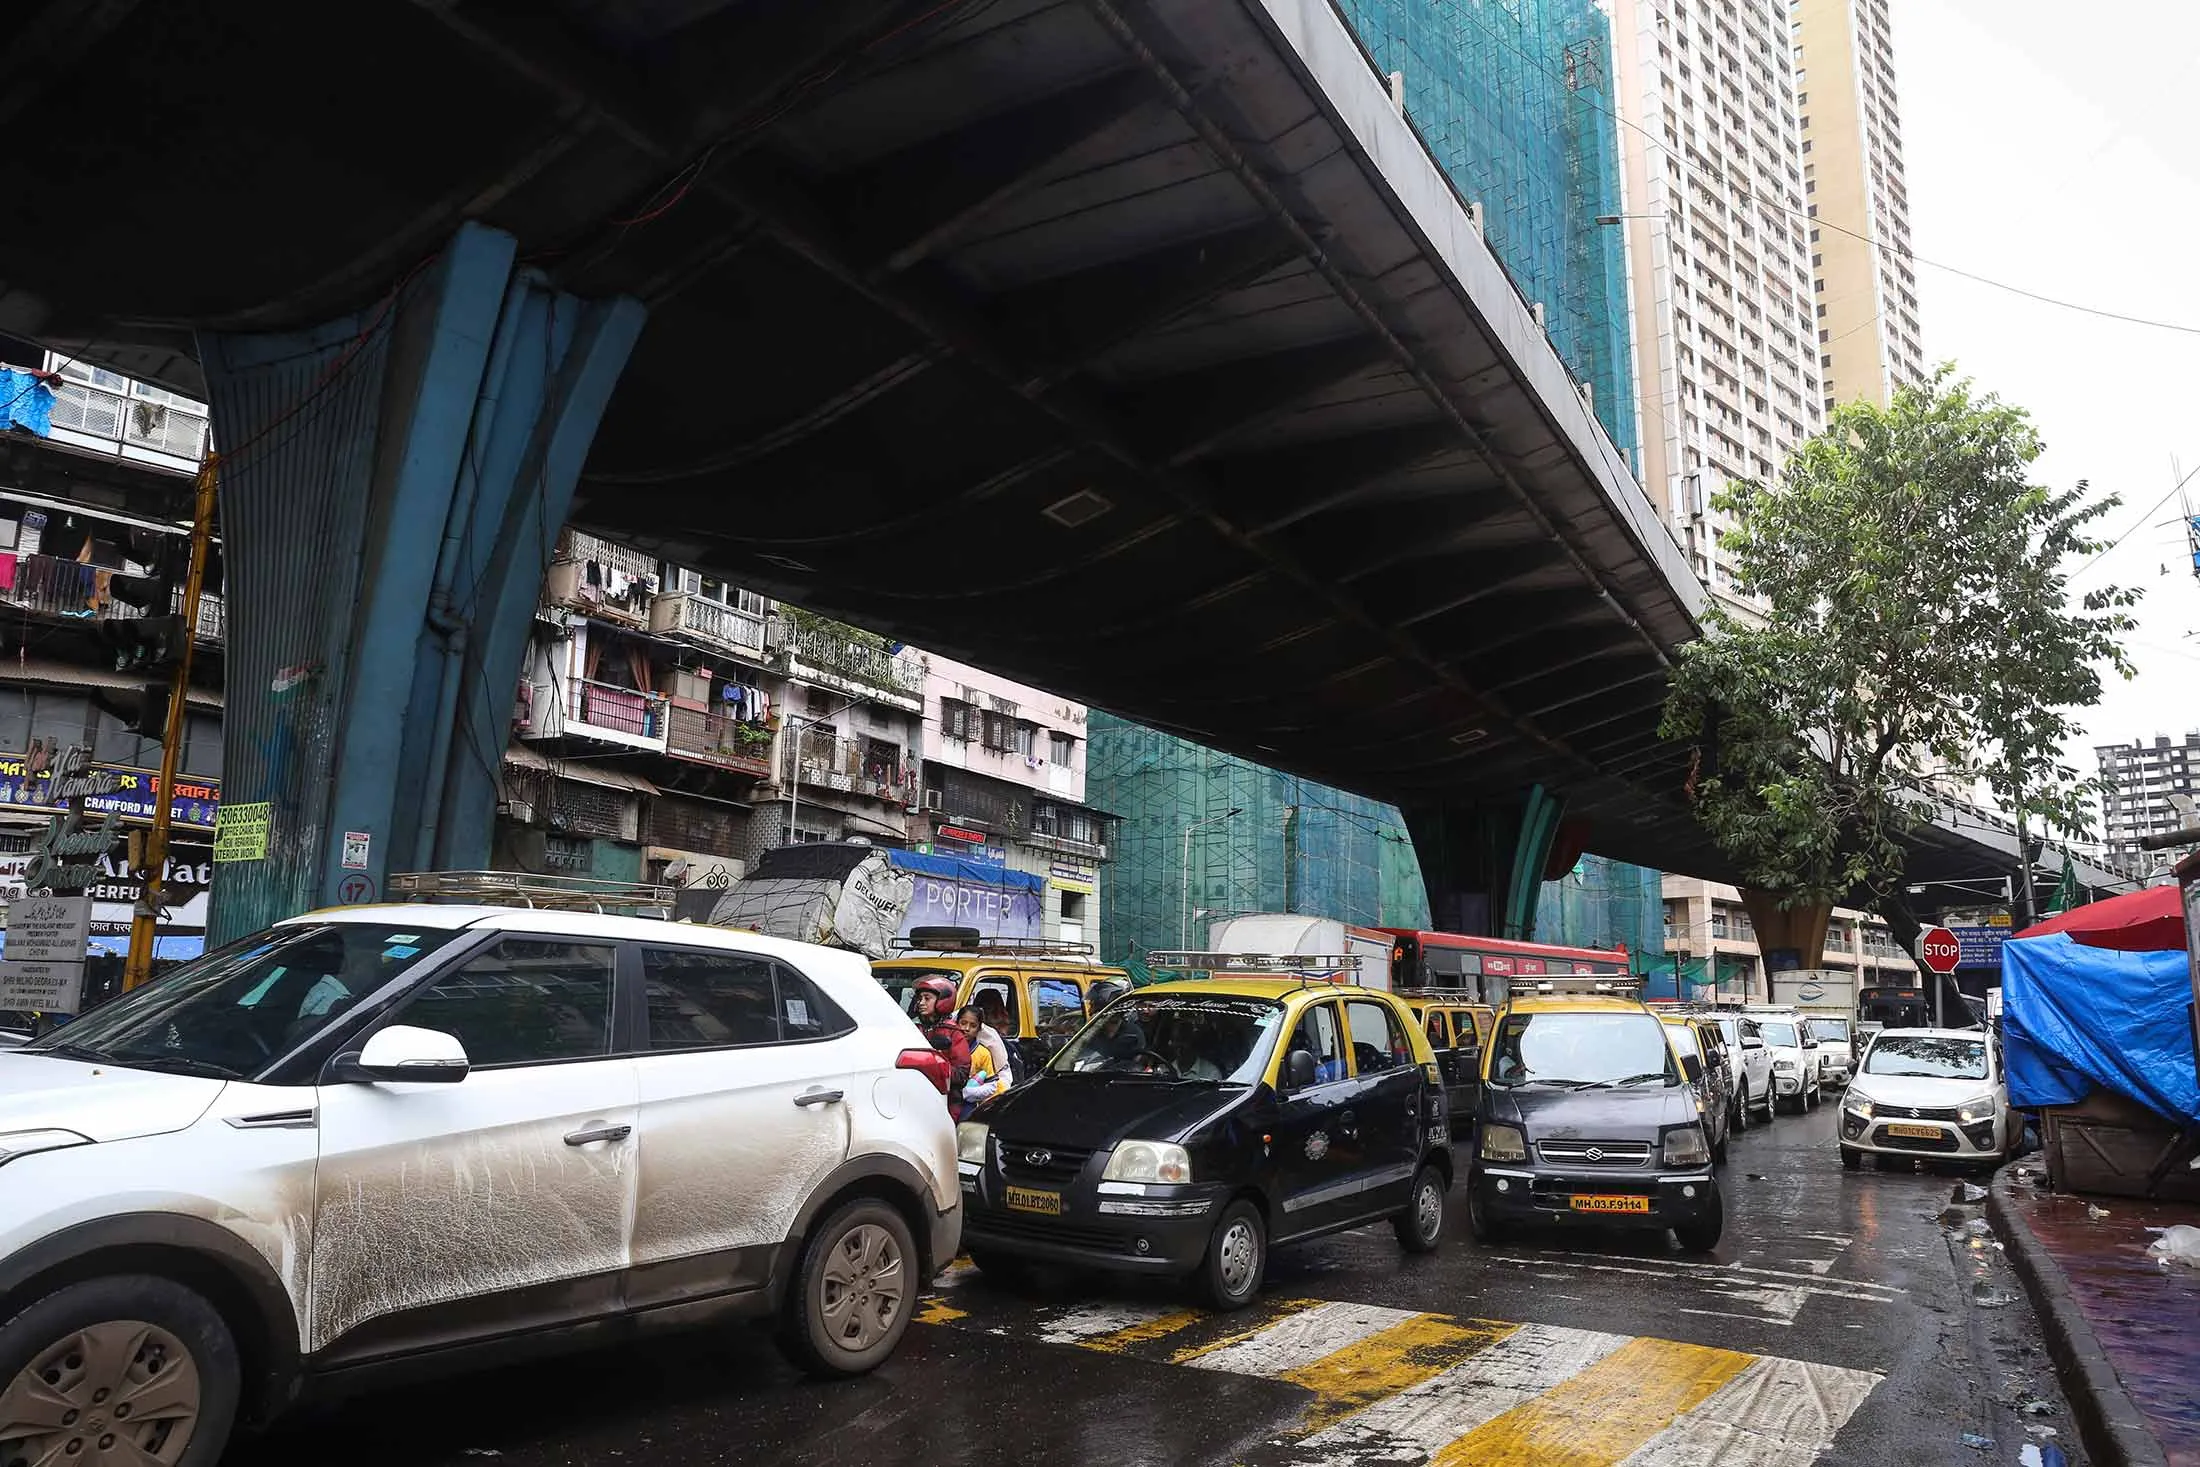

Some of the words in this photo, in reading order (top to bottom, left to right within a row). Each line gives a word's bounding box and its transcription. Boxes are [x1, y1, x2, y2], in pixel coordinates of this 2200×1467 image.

[84, 797, 140, 813] CRAWFORD
[143, 804, 183, 818] MAET
[346, 883, 367, 902] 17
[926, 883, 1012, 921] PORTER
[1925, 944, 1957, 957] STOP
